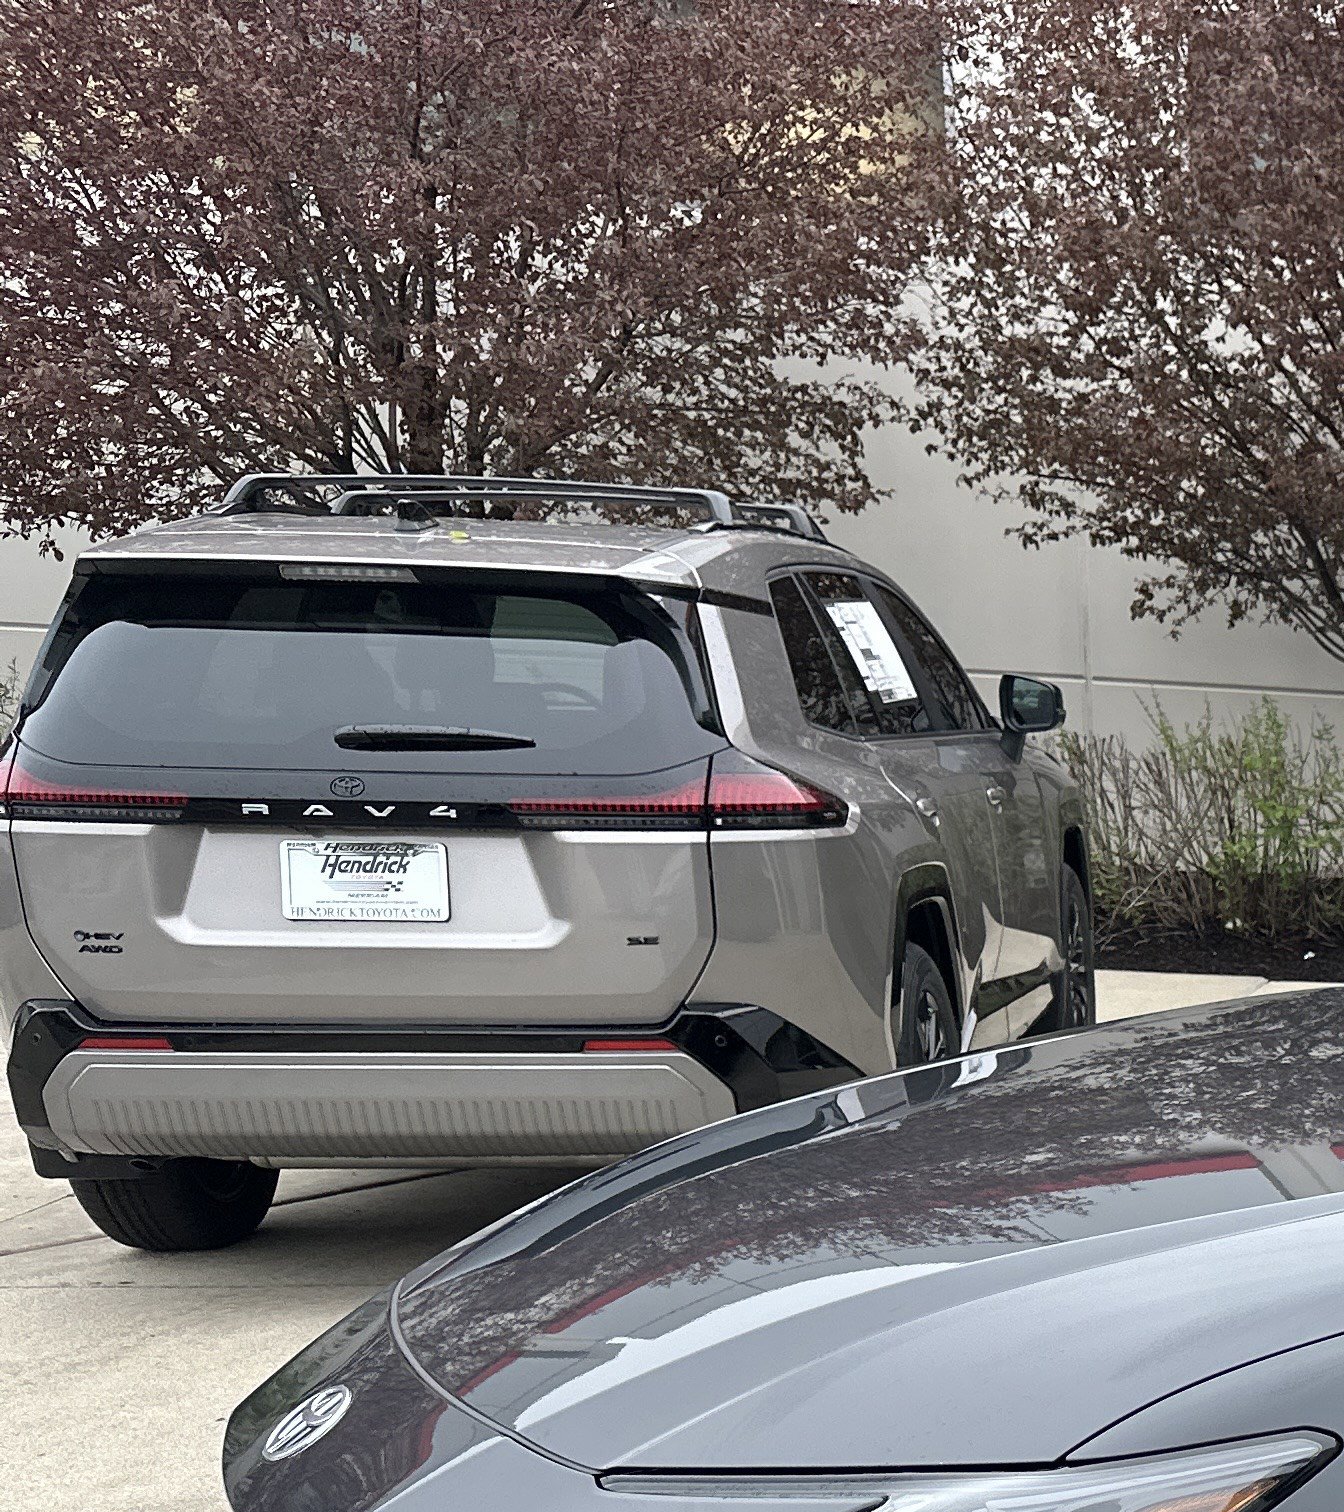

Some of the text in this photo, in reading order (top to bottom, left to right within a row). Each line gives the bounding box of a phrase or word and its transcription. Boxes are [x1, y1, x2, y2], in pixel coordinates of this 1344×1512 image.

[241, 803, 458, 818] RAV4
[320, 855, 411, 880] Hendrick
[78, 944, 123, 954] AWD
